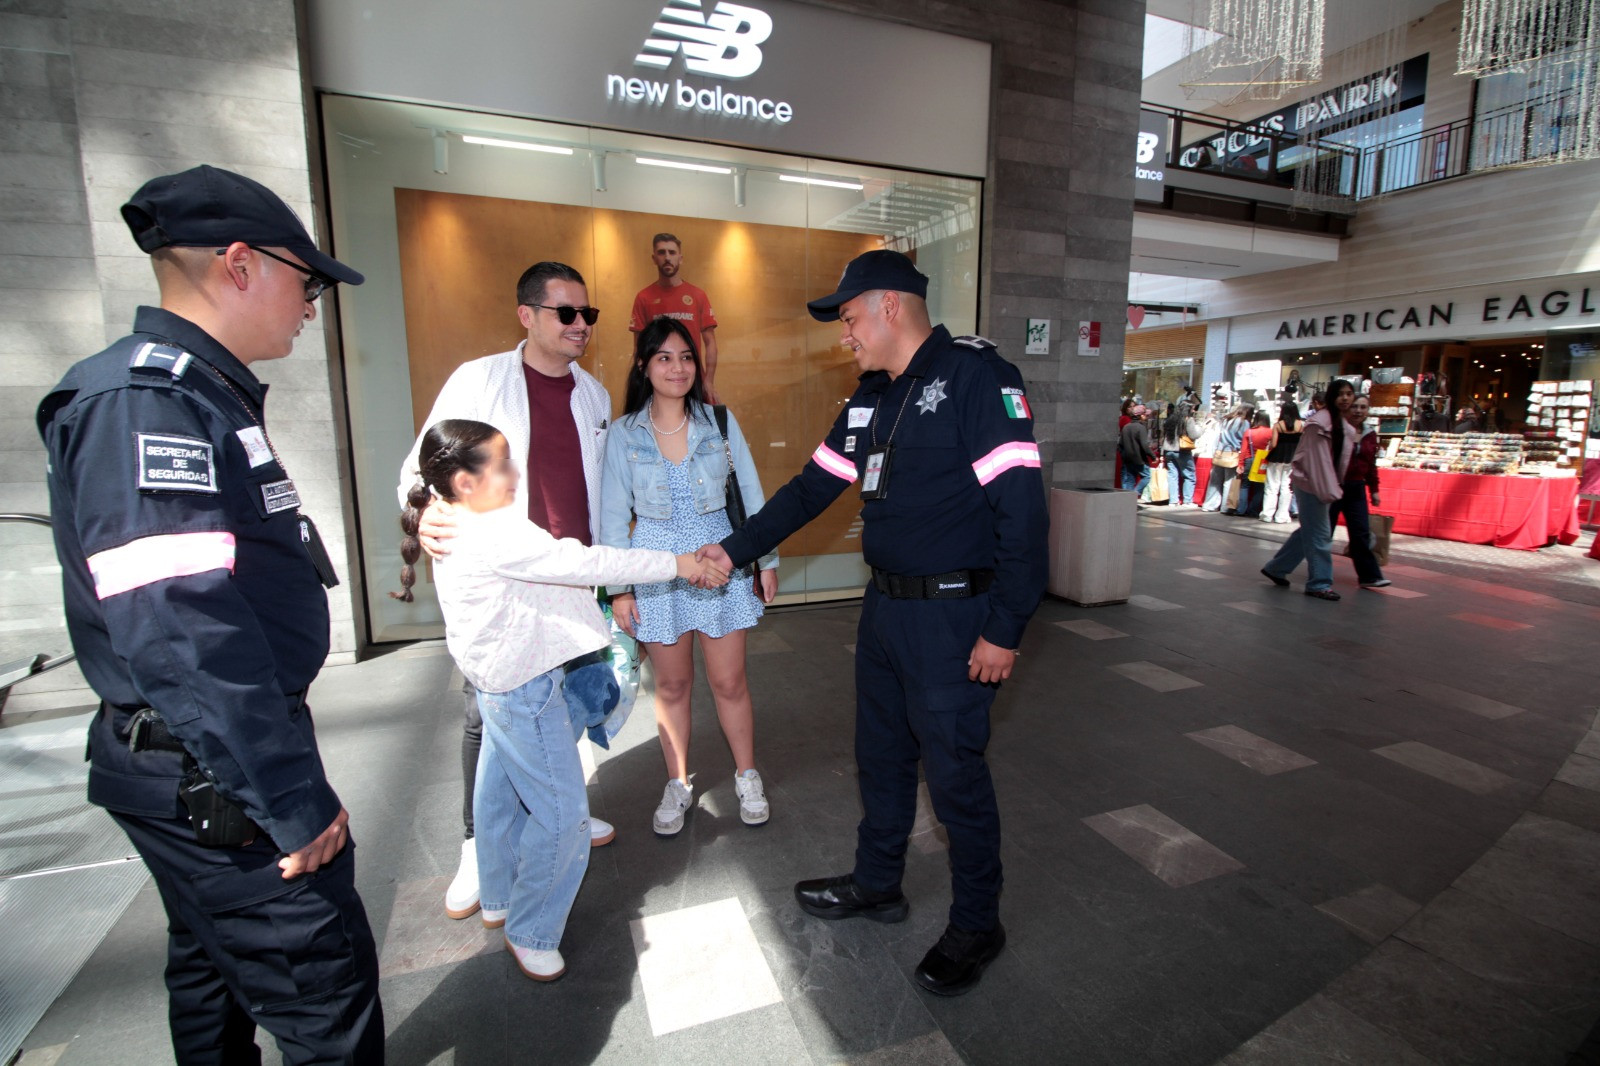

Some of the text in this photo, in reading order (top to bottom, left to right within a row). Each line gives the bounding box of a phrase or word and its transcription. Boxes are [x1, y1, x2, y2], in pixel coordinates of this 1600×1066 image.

[607, 74, 793, 124] new balance
[1295, 70, 1398, 131] PARK
[1275, 287, 1596, 341] AMERICAN EAGL
[172, 458, 189, 469] DE
